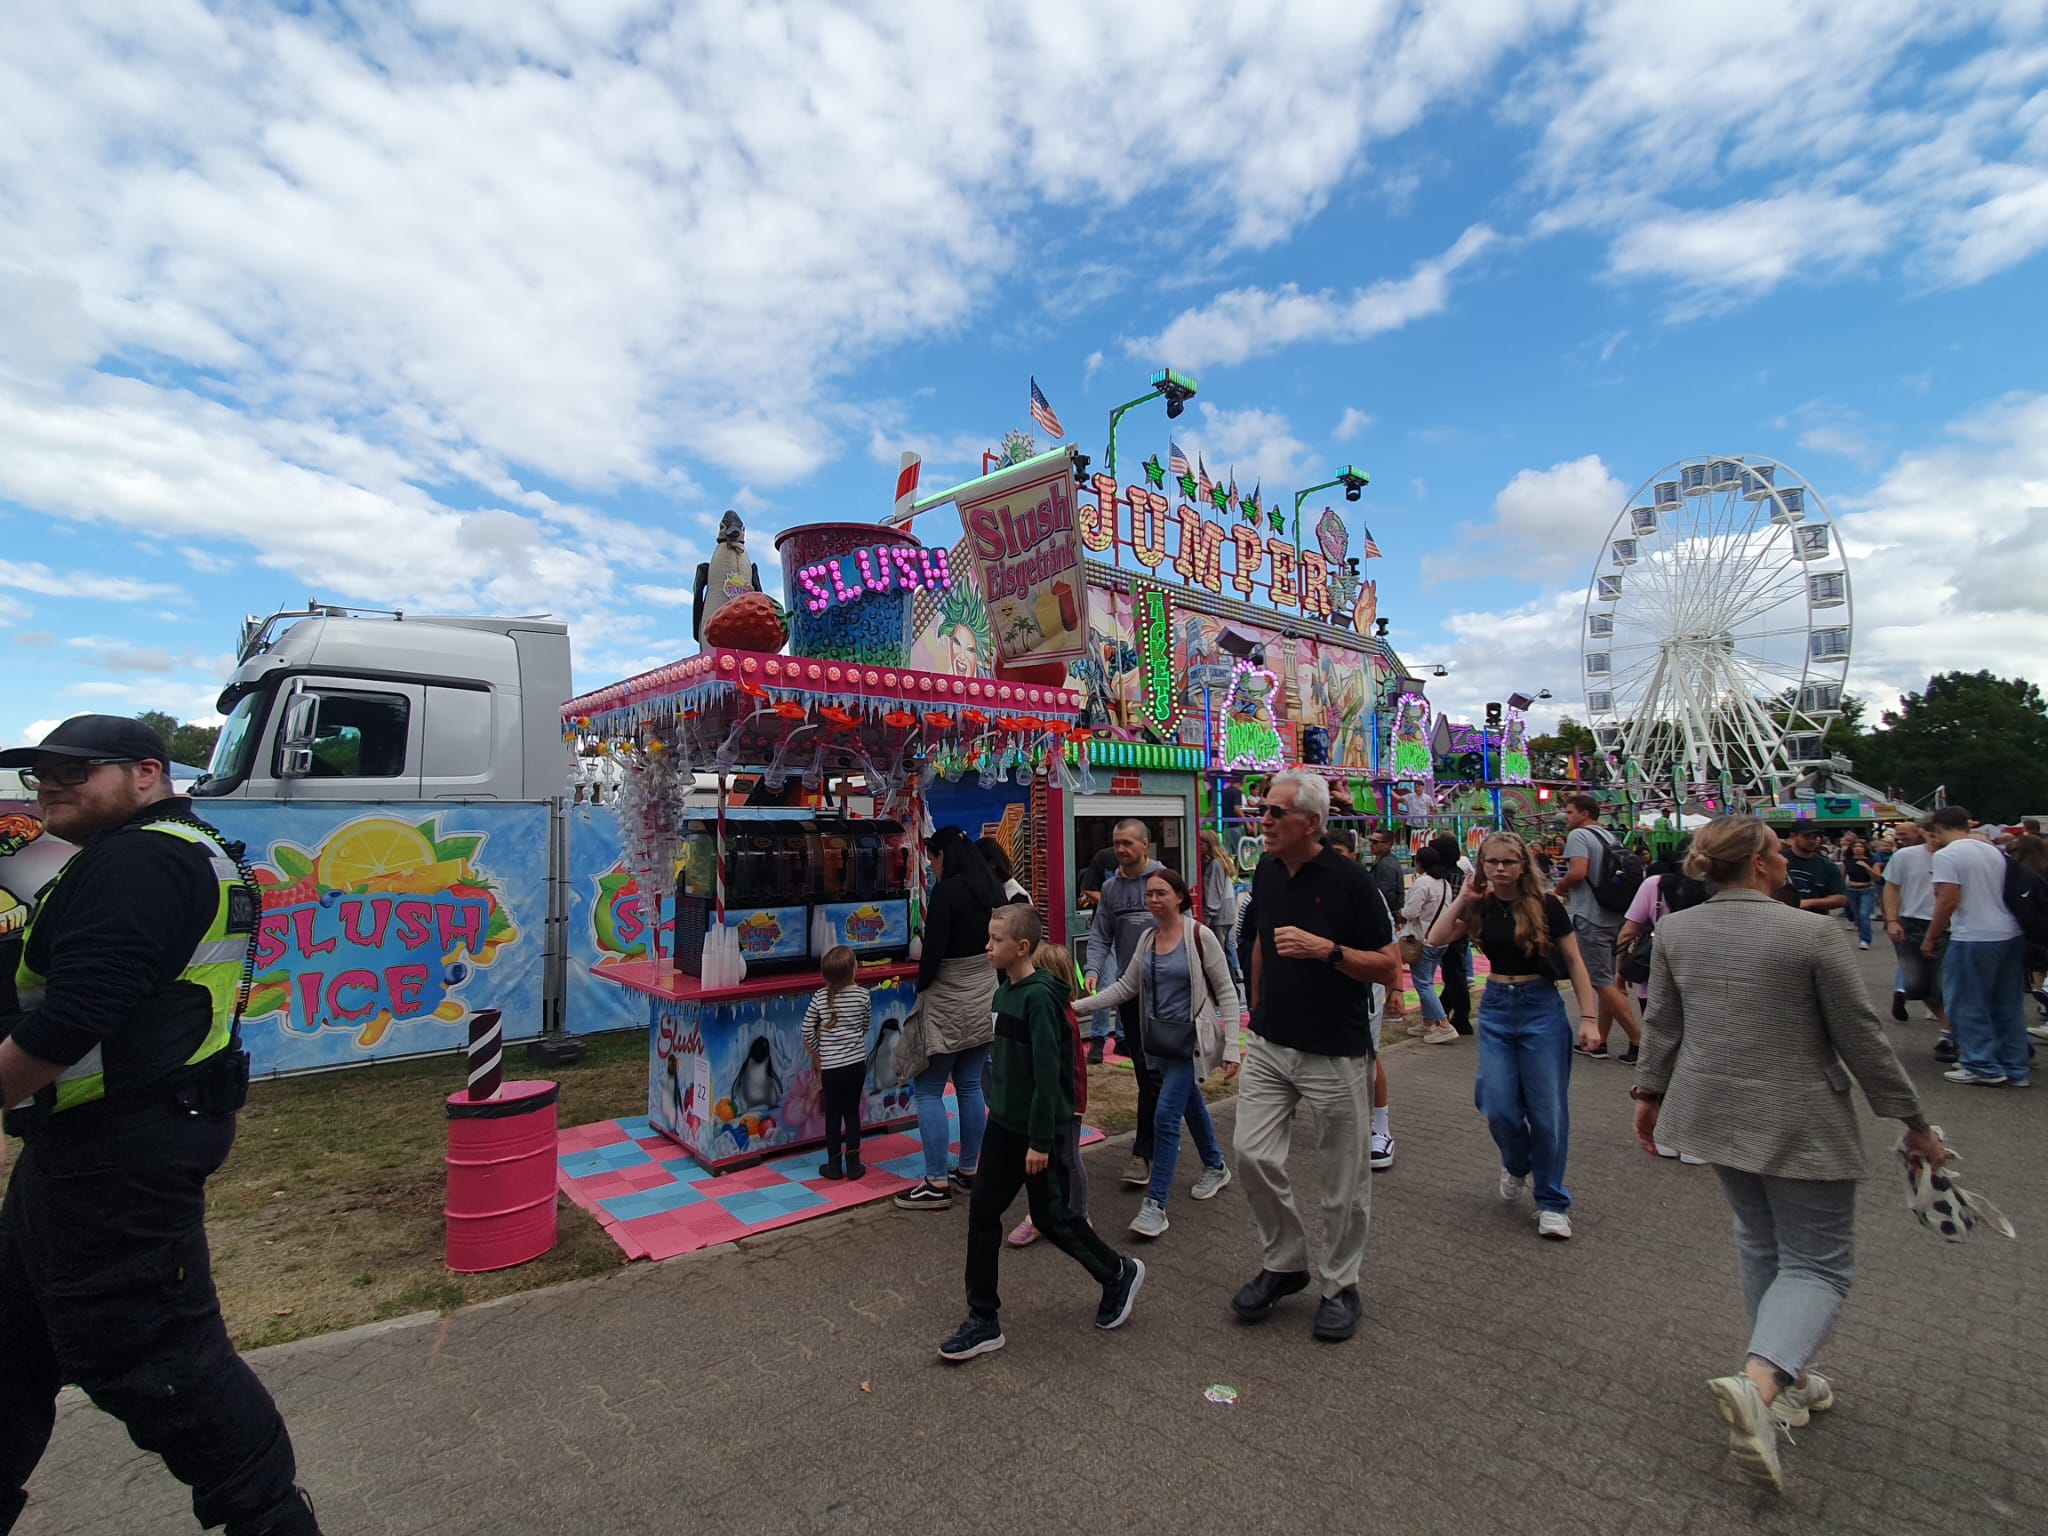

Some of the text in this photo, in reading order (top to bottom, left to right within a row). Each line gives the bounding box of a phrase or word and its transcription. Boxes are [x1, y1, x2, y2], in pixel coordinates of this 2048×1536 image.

[969, 483, 1073, 561] Slush
[1079, 472, 1332, 616] JUMPER
[797, 546, 951, 615] SLUSH
[985, 534, 1077, 604] Eisgetränk
[1146, 592, 1170, 721] TICKETS
[255, 898, 482, 969] SLUSH
[298, 964, 428, 1026] ICE
[657, 1013, 704, 1059] Slush
